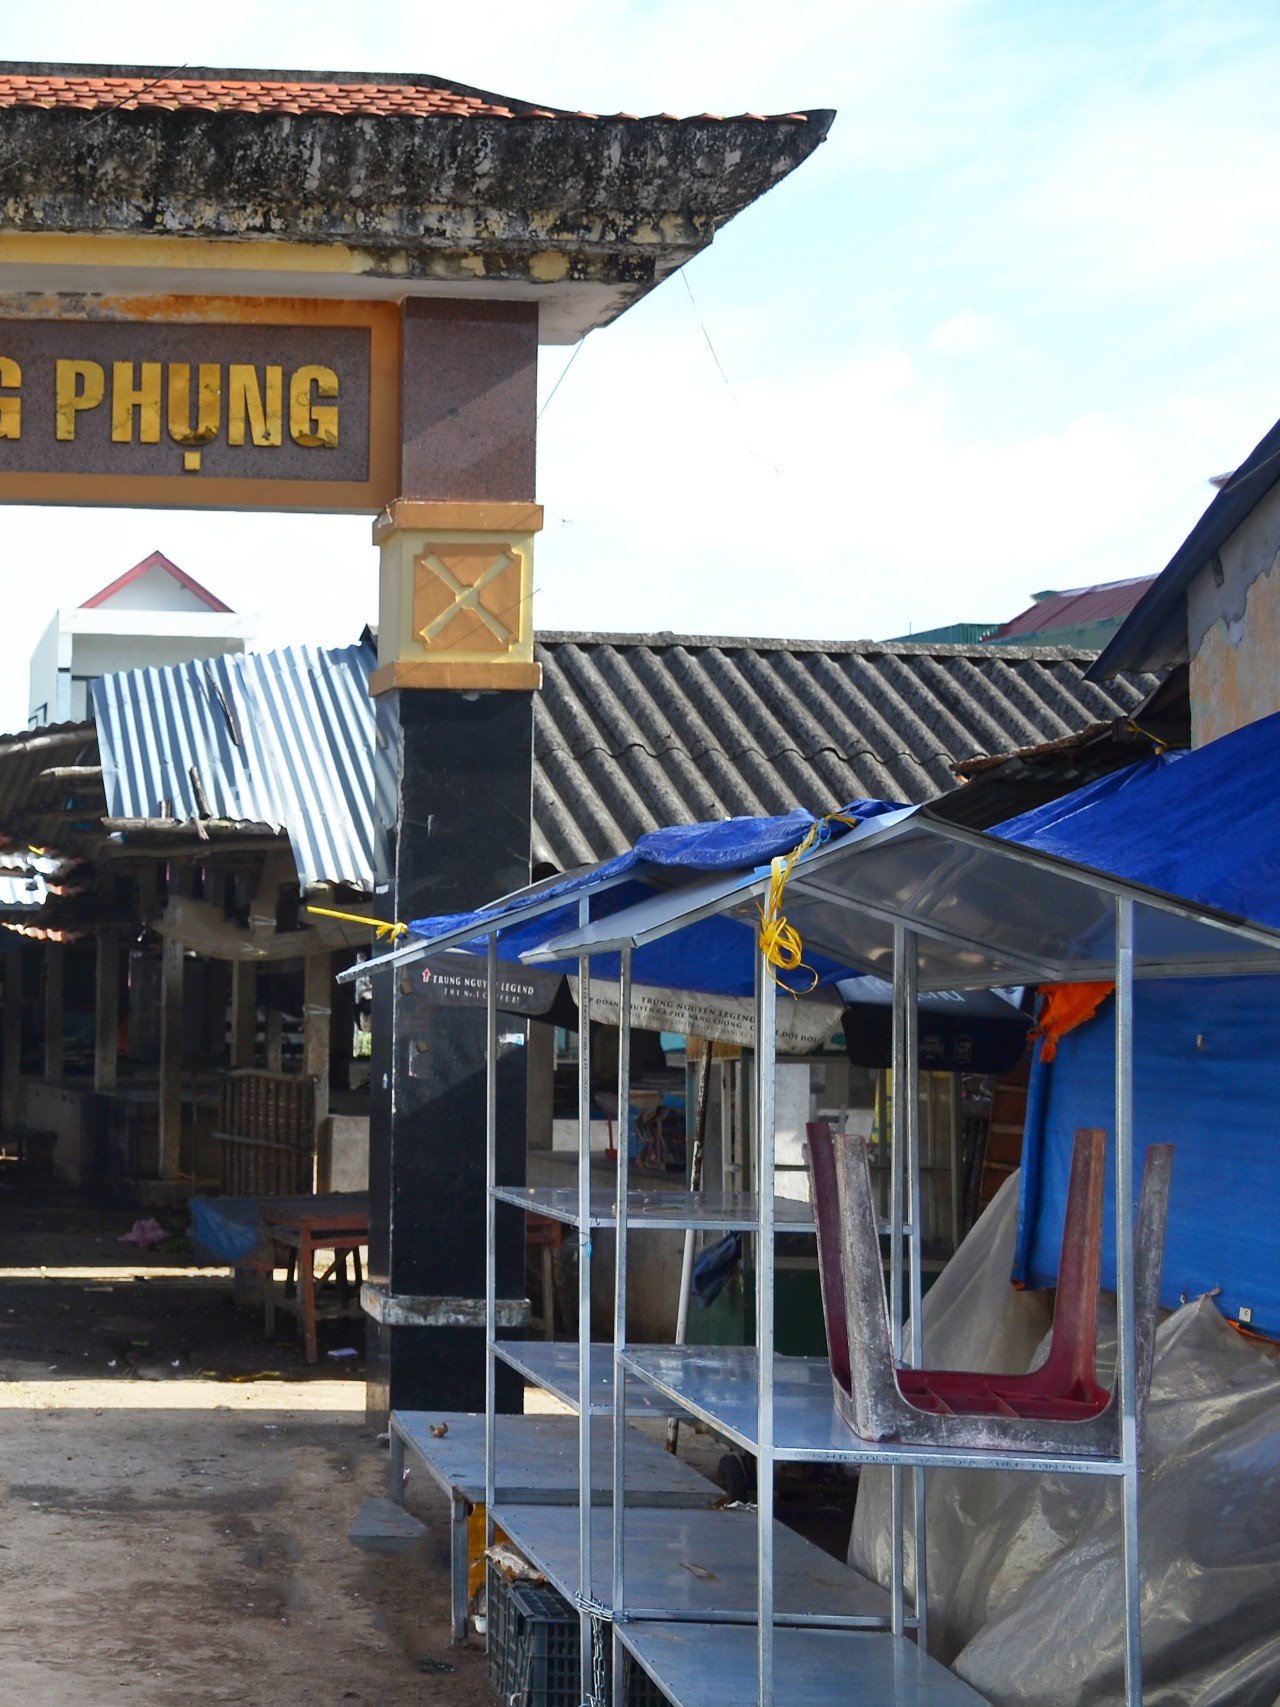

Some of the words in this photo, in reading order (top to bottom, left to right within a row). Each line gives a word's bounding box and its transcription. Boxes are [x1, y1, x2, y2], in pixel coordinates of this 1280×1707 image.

[54, 358, 340, 472] PHỤNG
[432, 974, 461, 986] TRUNG
[464, 978, 499, 988] NGUY
[500, 982, 535, 996] LEGEND
[443, 987, 460, 997] THE
[641, 996, 673, 1008] TRUNG
